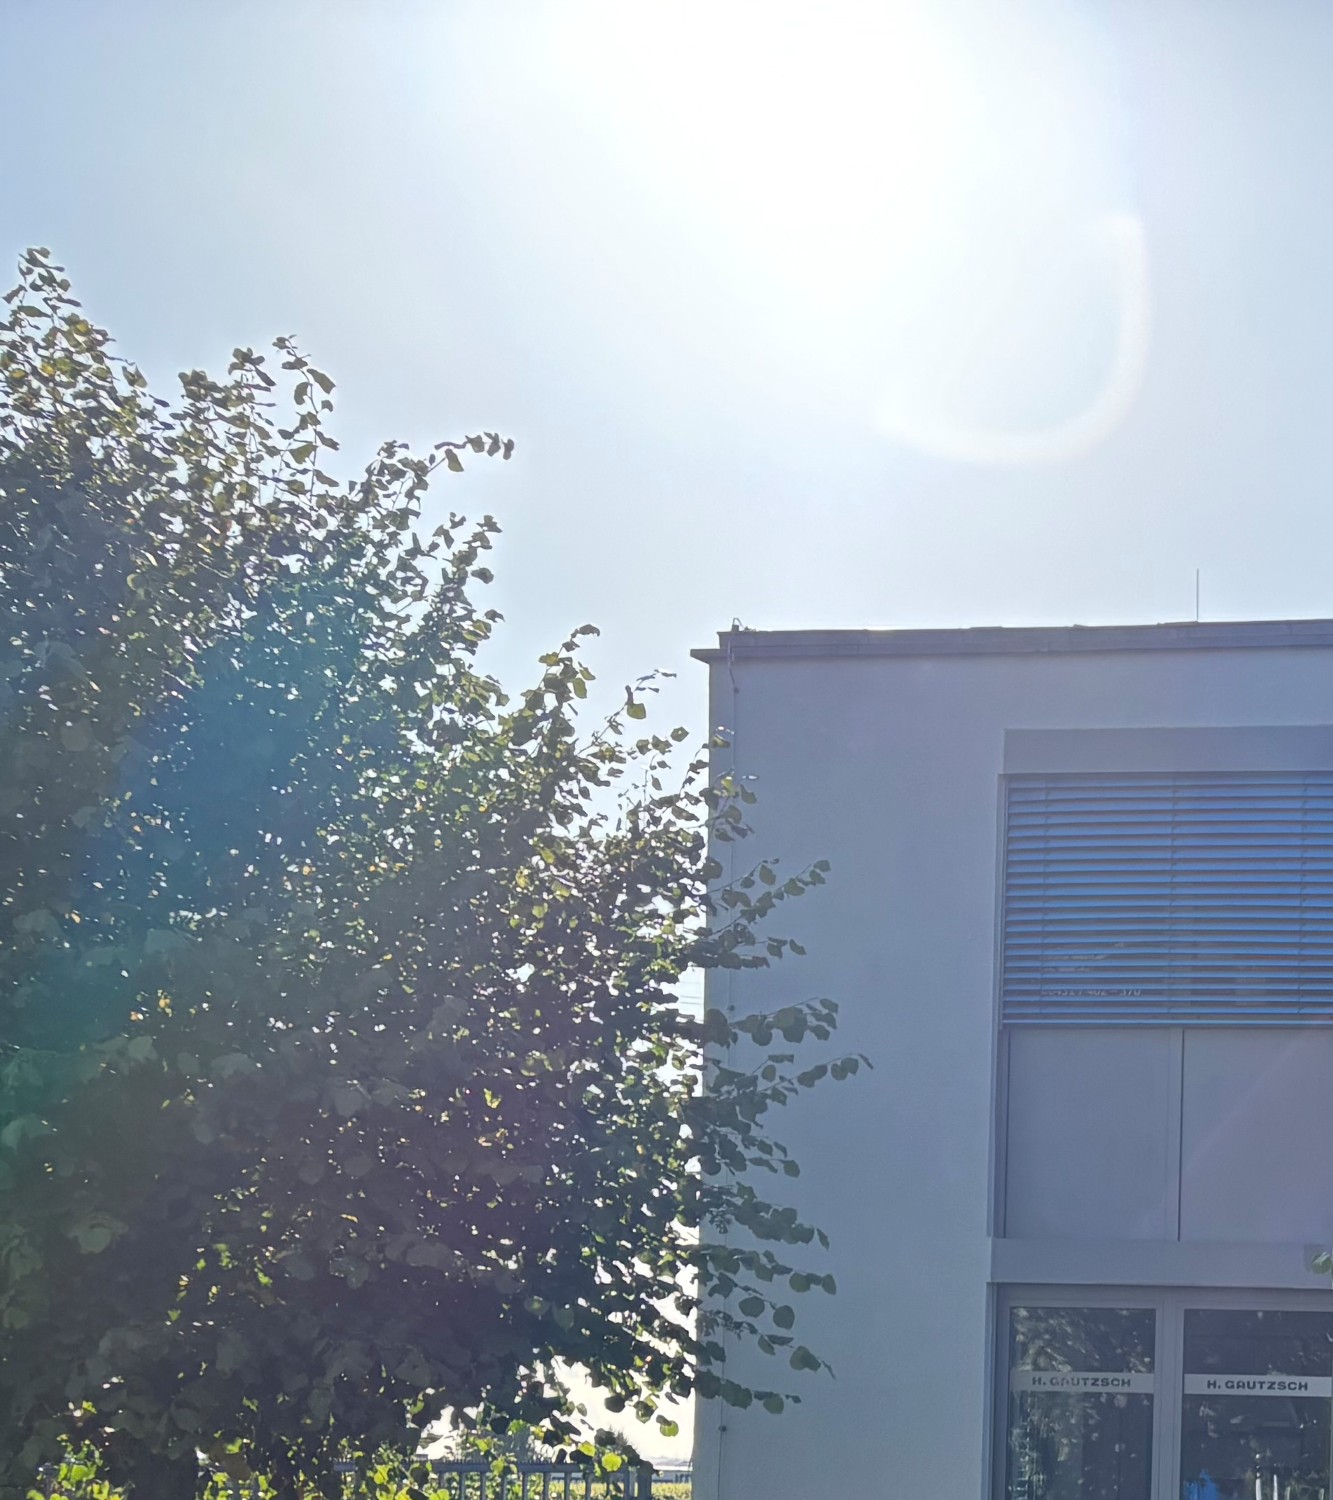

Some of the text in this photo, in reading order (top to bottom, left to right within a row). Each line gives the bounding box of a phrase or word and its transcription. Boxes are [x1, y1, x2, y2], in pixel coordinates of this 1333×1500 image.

[1031, 1376, 1132, 1388] H. GAUTZSCH
[1206, 1380, 1309, 1391] H. GAUTZSCH
